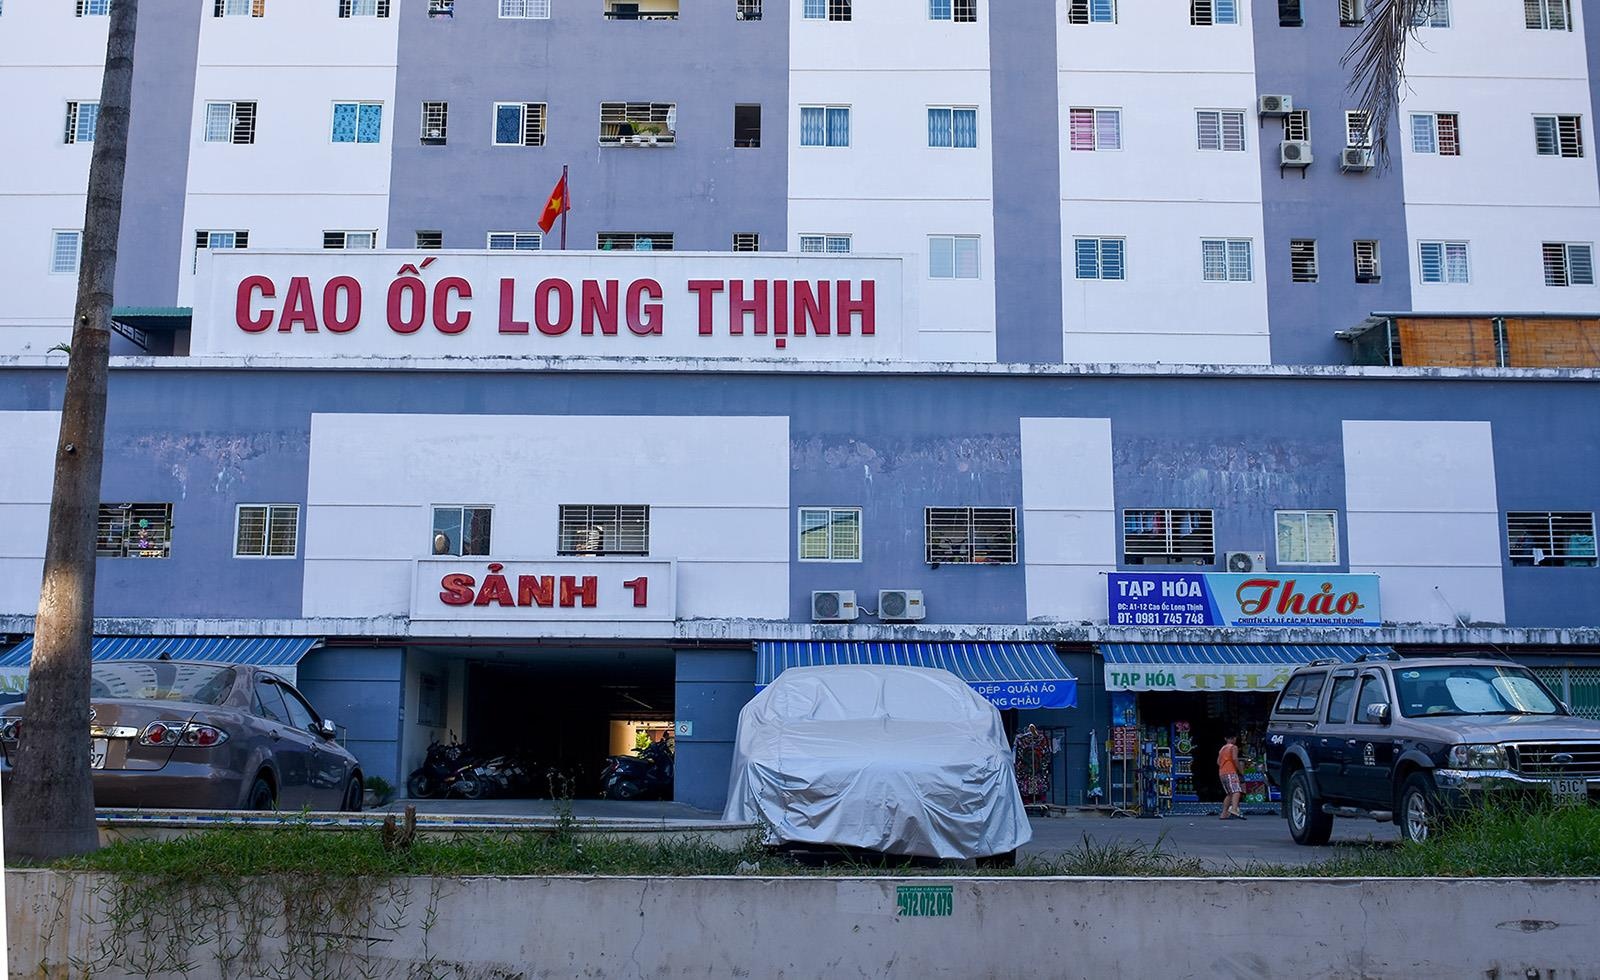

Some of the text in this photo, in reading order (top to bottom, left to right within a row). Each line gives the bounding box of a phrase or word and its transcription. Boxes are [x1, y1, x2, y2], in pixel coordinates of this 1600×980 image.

[235, 256, 877, 348] CAO ỐC LONG THỊNH
[439, 563, 648, 608] SẢNH 1
[1117, 578, 1203, 600] TẠP HÓA
[1235, 578, 1365, 616] Thảo
[1129, 603, 1148, 611] A1-12
[1148, 603, 1161, 611] Cao
[1161, 601, 1170, 611] Ốc
[1170, 603, 1186, 612] Long
[1186, 603, 1204, 613] Thịnh
[1117, 612, 1204, 625] ĐT: 0981 745 748
[1110, 672, 1141, 688] TẠP
[1145, 669, 1176, 687] HÓA
[1010, 695, 1040, 706] CHÂU
[1560, 780, 1580, 793] 51C
